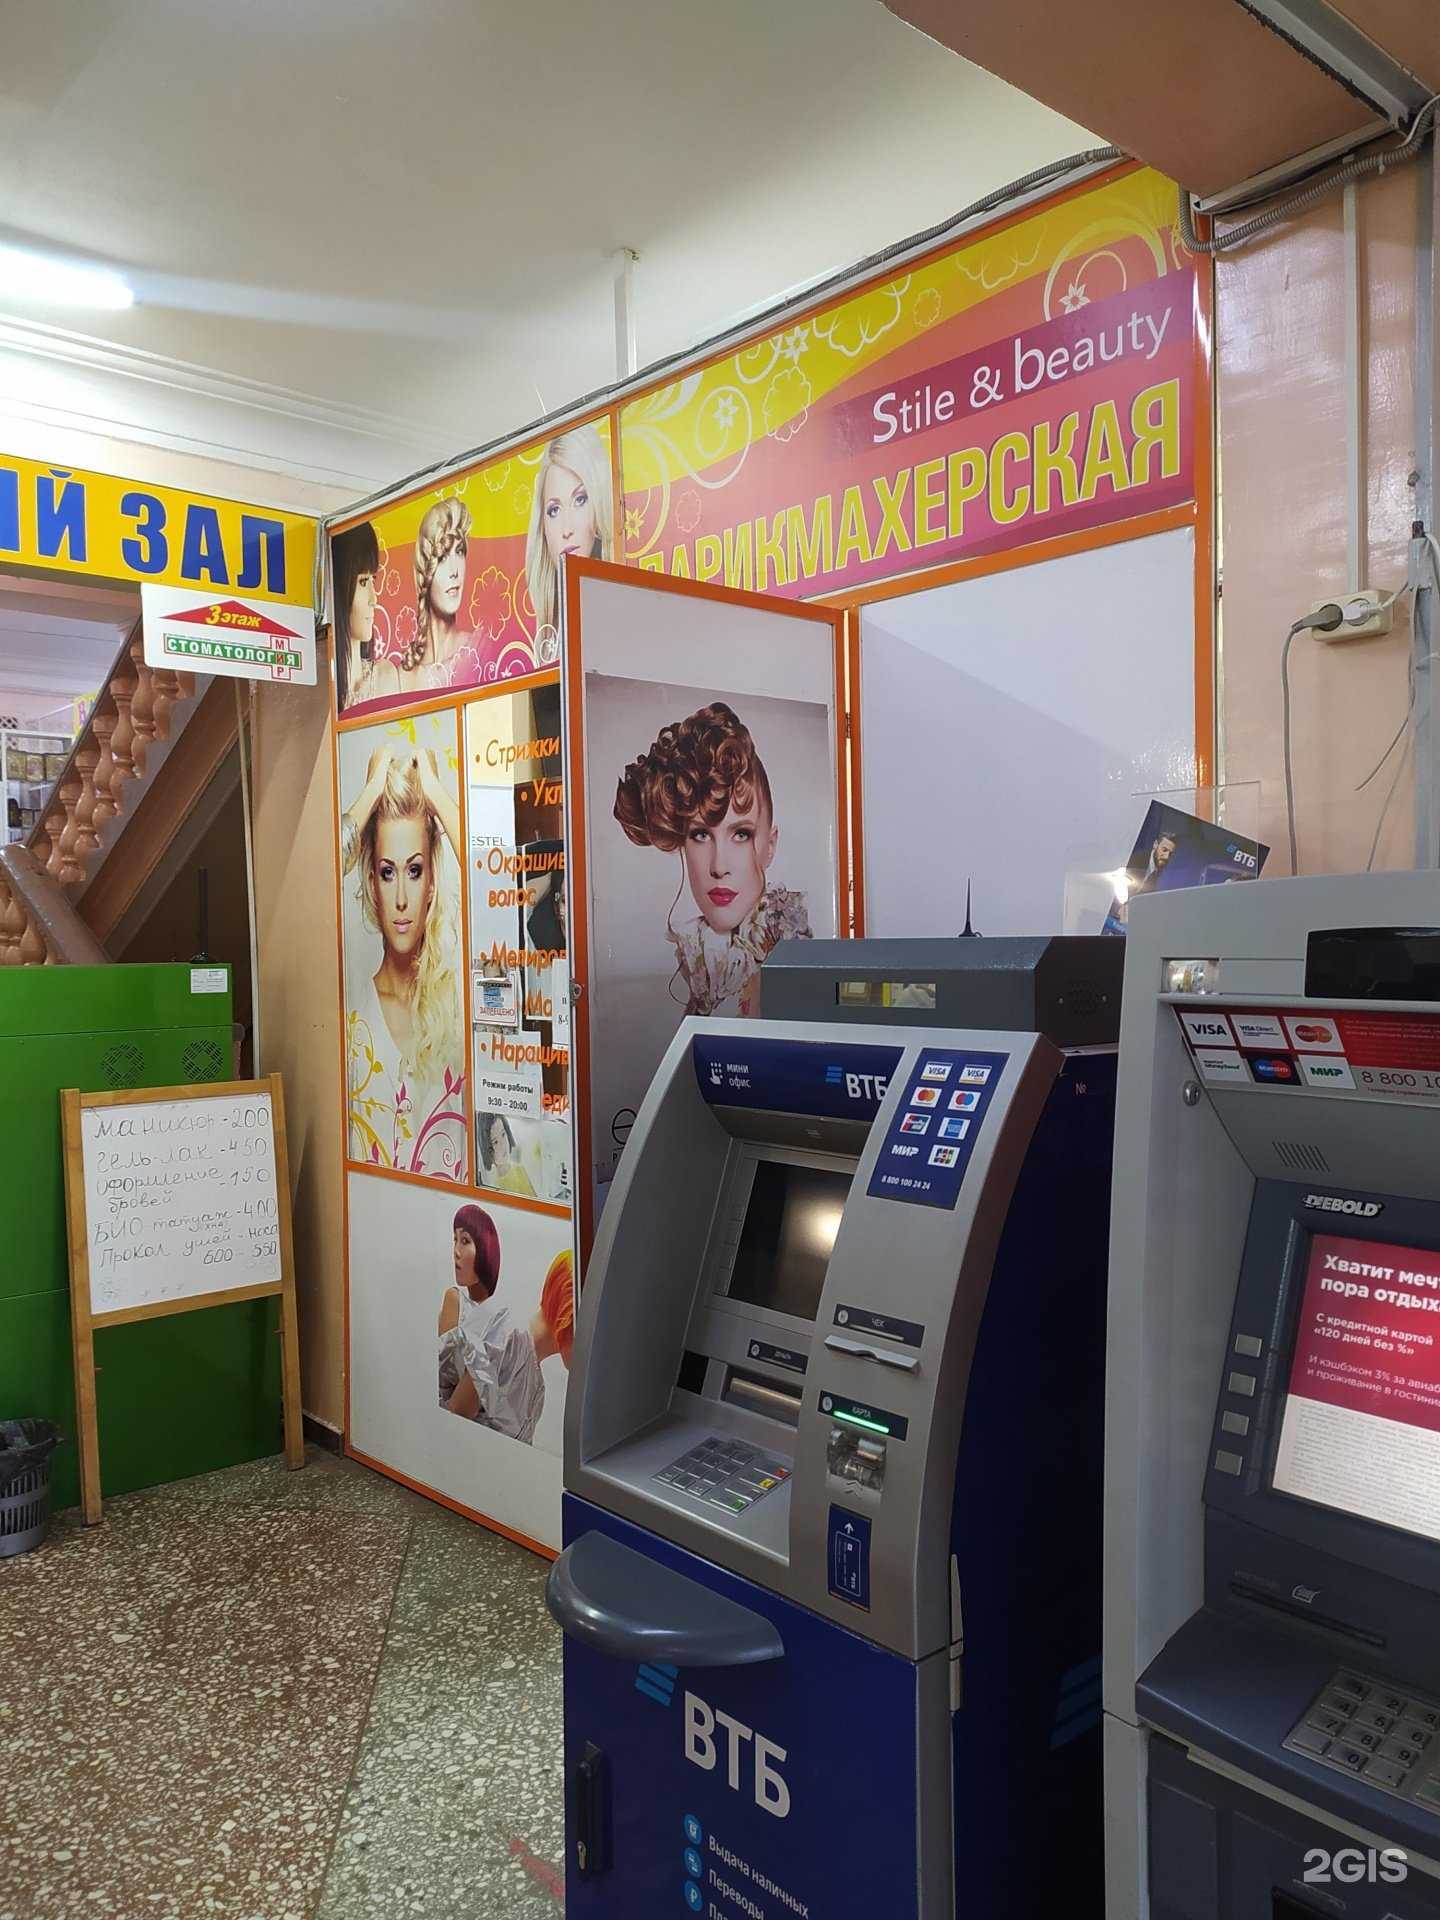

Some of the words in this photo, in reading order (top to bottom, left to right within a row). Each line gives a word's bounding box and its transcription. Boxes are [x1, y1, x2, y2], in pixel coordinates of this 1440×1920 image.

[872, 384, 955, 443] Stile
[970, 366, 1004, 408] &
[1014, 307, 1172, 393] beauty
[639, 379, 1180, 593] АРИКМАХЕРСКАЯ
[120, 492, 286, 595] ЗАЛ
[485, 736, 560, 773] Стрижки
[1233, 849, 1257, 868] ВТБ
[488, 888, 537, 908] волос
[1190, 1023, 1227, 1035] VISA
[726, 1063, 750, 1074] мини
[928, 1066, 946, 1075] VISA
[966, 1069, 985, 1077] VISA
[1310, 1066, 1343, 1077] МИР
[1362, 1071, 1374, 1084] 8
[1379, 1072, 1417, 1087] 800
[482, 1078, 506, 1090] Режим
[507, 1083, 534, 1095] работы
[729, 1075, 752, 1090] офис
[846, 1072, 888, 1101] ВТБ
[487, 1096, 502, 1107] 9:30
[509, 1100, 528, 1111] 20:00
[891, 1144, 920, 1157] МИР
[1303, 1194, 1379, 1217] DIEBOLD
[1323, 1254, 1394, 1280] Хватит
[1398, 1270, 1440, 1289] меч
[1320, 1278, 1370, 1298] пора
[1374, 1288, 1440, 1312] отдых
[1316, 1312, 1325, 1323] С
[1327, 1316, 1388, 1336] кредитной
[1391, 1329, 1434, 1346] картой
[1342, 1332, 1371, 1346] дней
[1373, 1338, 1394, 1352] без
[1309, 1354, 1318, 1364] И
[1319, 1358, 1372, 1377] кэшбэком
[1393, 1375, 1405, 1385] за
[1316, 1369, 1382, 1393] проживание
[1384, 1386, 1391, 1395] в
[684, 1690, 790, 1818] ВТБ
[709, 1834, 750, 1877] Выдача
[751, 1868, 809, 1920] наличных
[709, 1868, 765, 1920] Переводы
